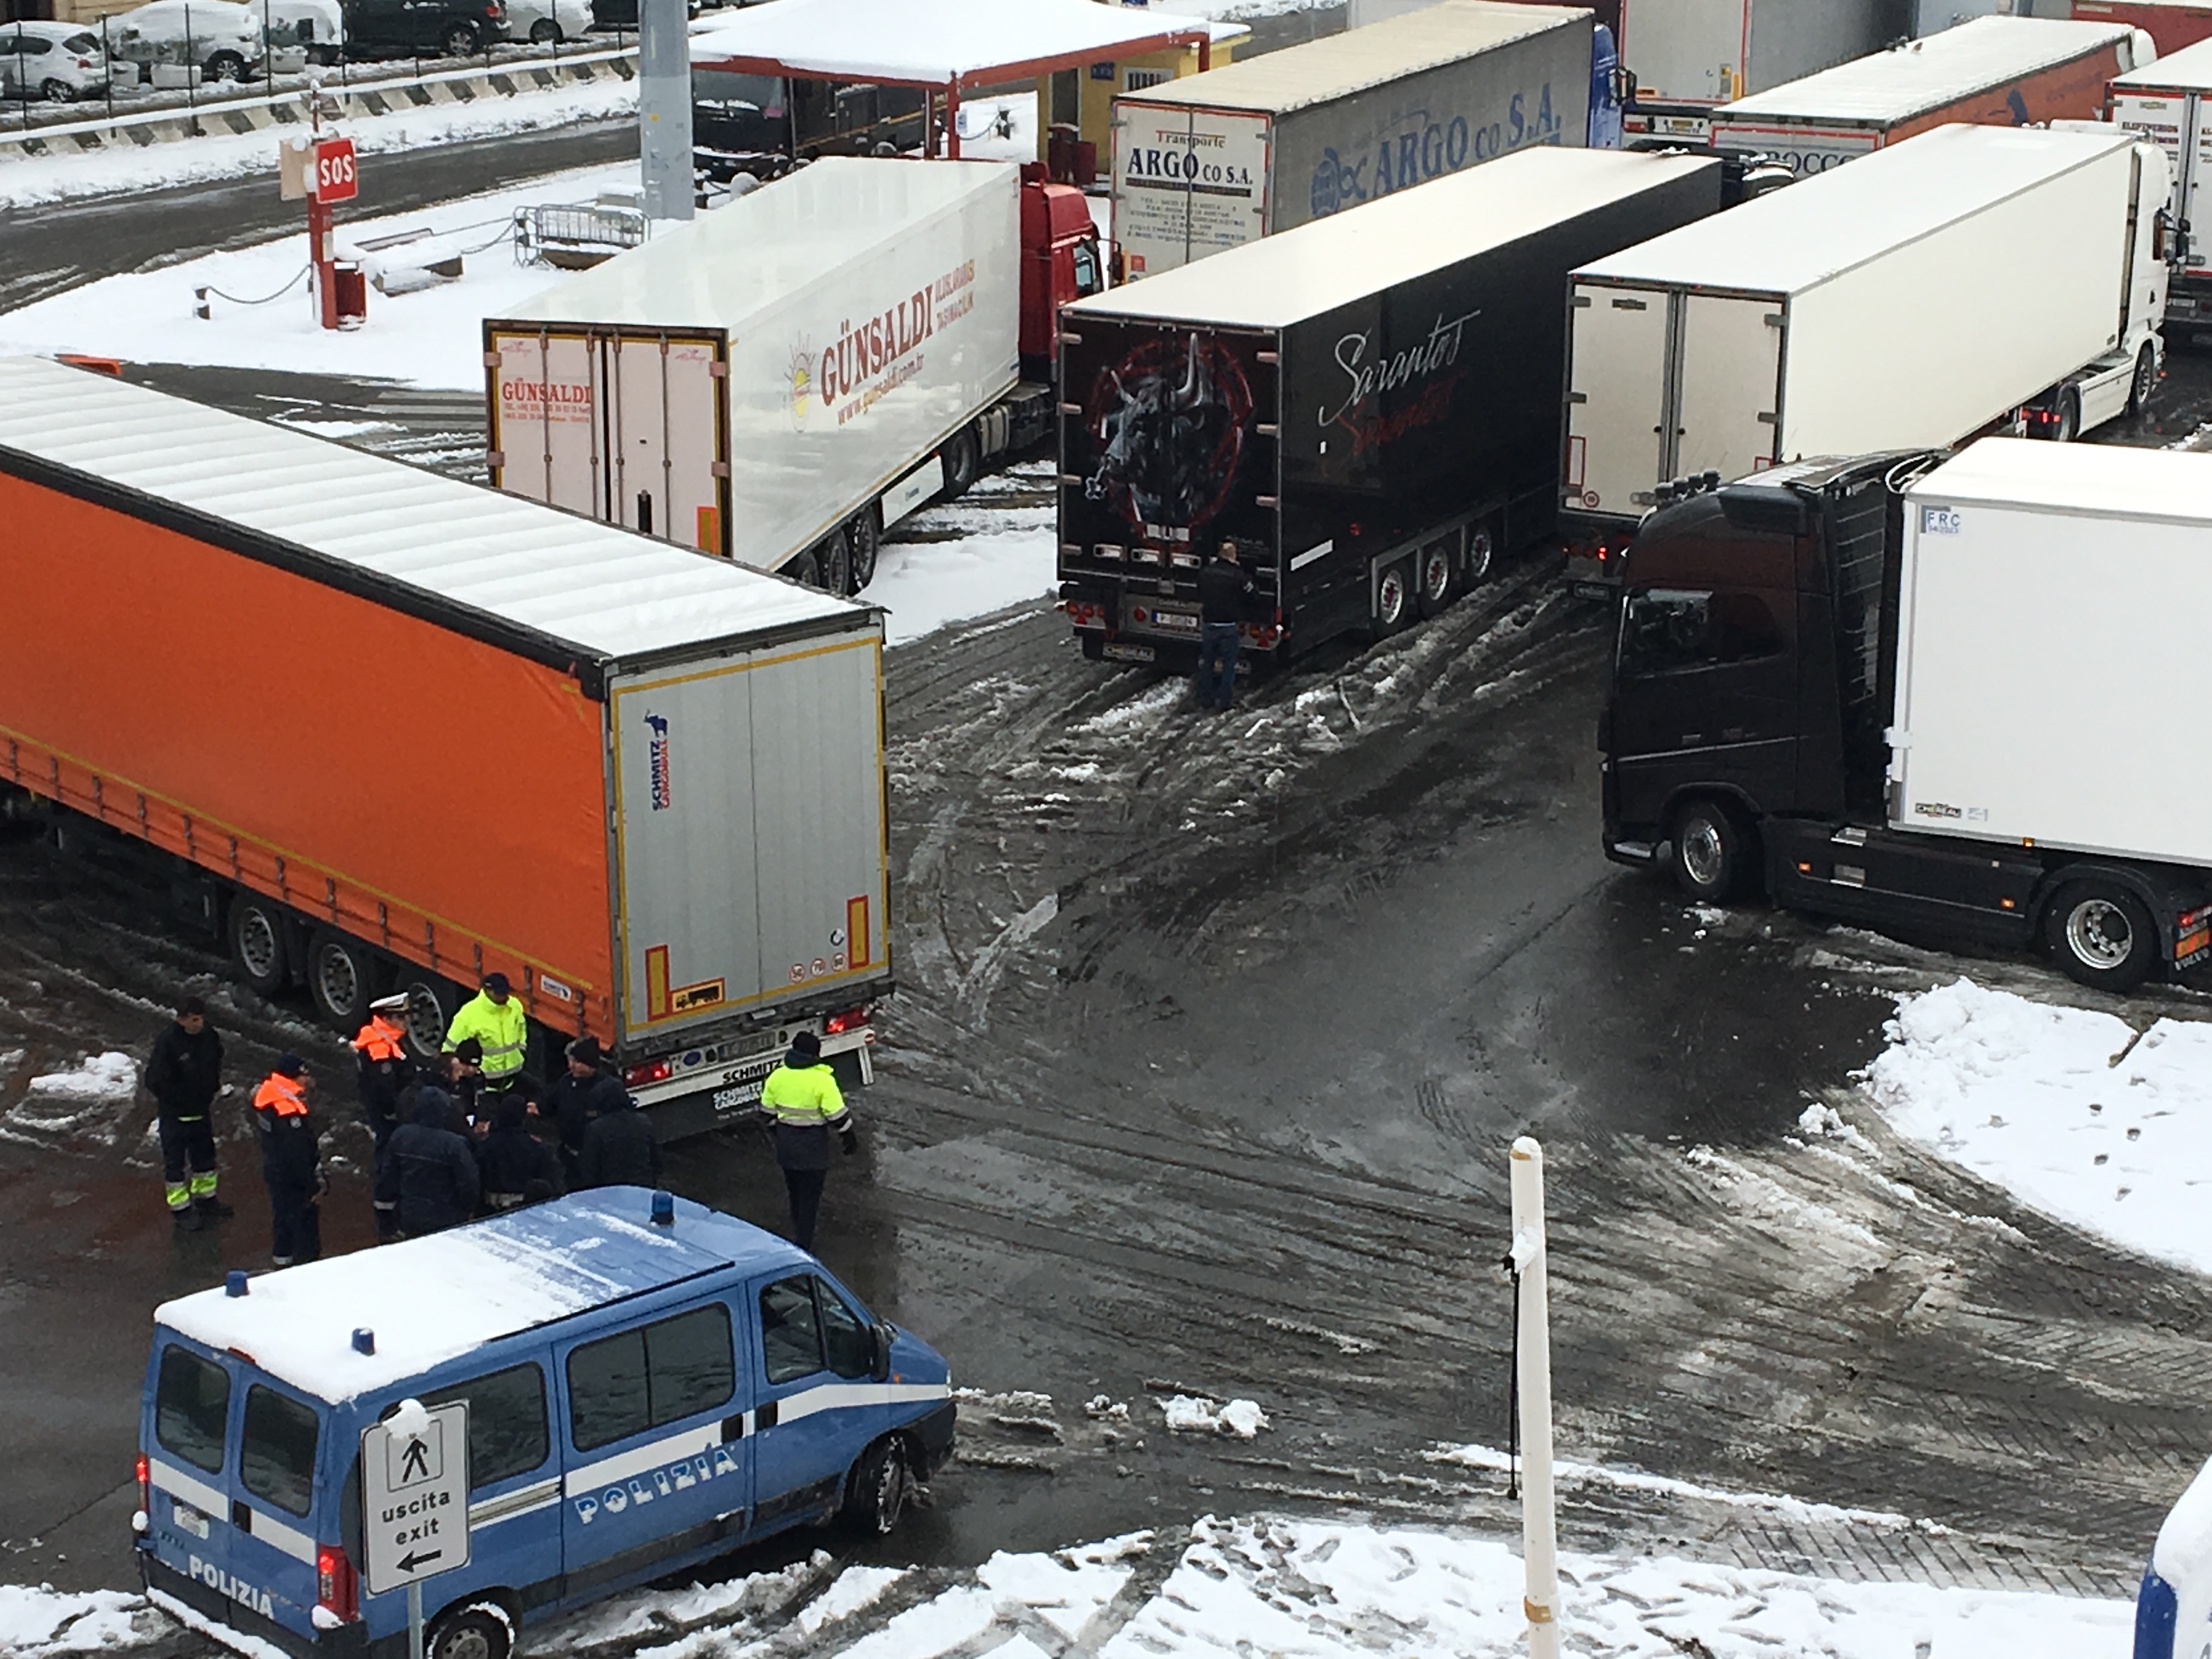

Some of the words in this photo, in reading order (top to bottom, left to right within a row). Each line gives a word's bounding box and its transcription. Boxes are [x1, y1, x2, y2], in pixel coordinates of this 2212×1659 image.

[320, 154, 353, 187] SOS
[1127, 148, 1199, 179] ARGO
[1373, 116, 1468, 196] ARGO
[821, 284, 933, 407] GÜNSALDI
[1318, 309, 1481, 427] Sarantos
[650, 740, 663, 811] SCHMITZ
[723, 1059, 782, 1084] SCHMITZ
[382, 1491, 450, 1523] uscita
[574, 1449, 738, 1524] POLIZIA
[395, 1517, 439, 1545] exit
[189, 1554, 274, 1619] POLIZIA
